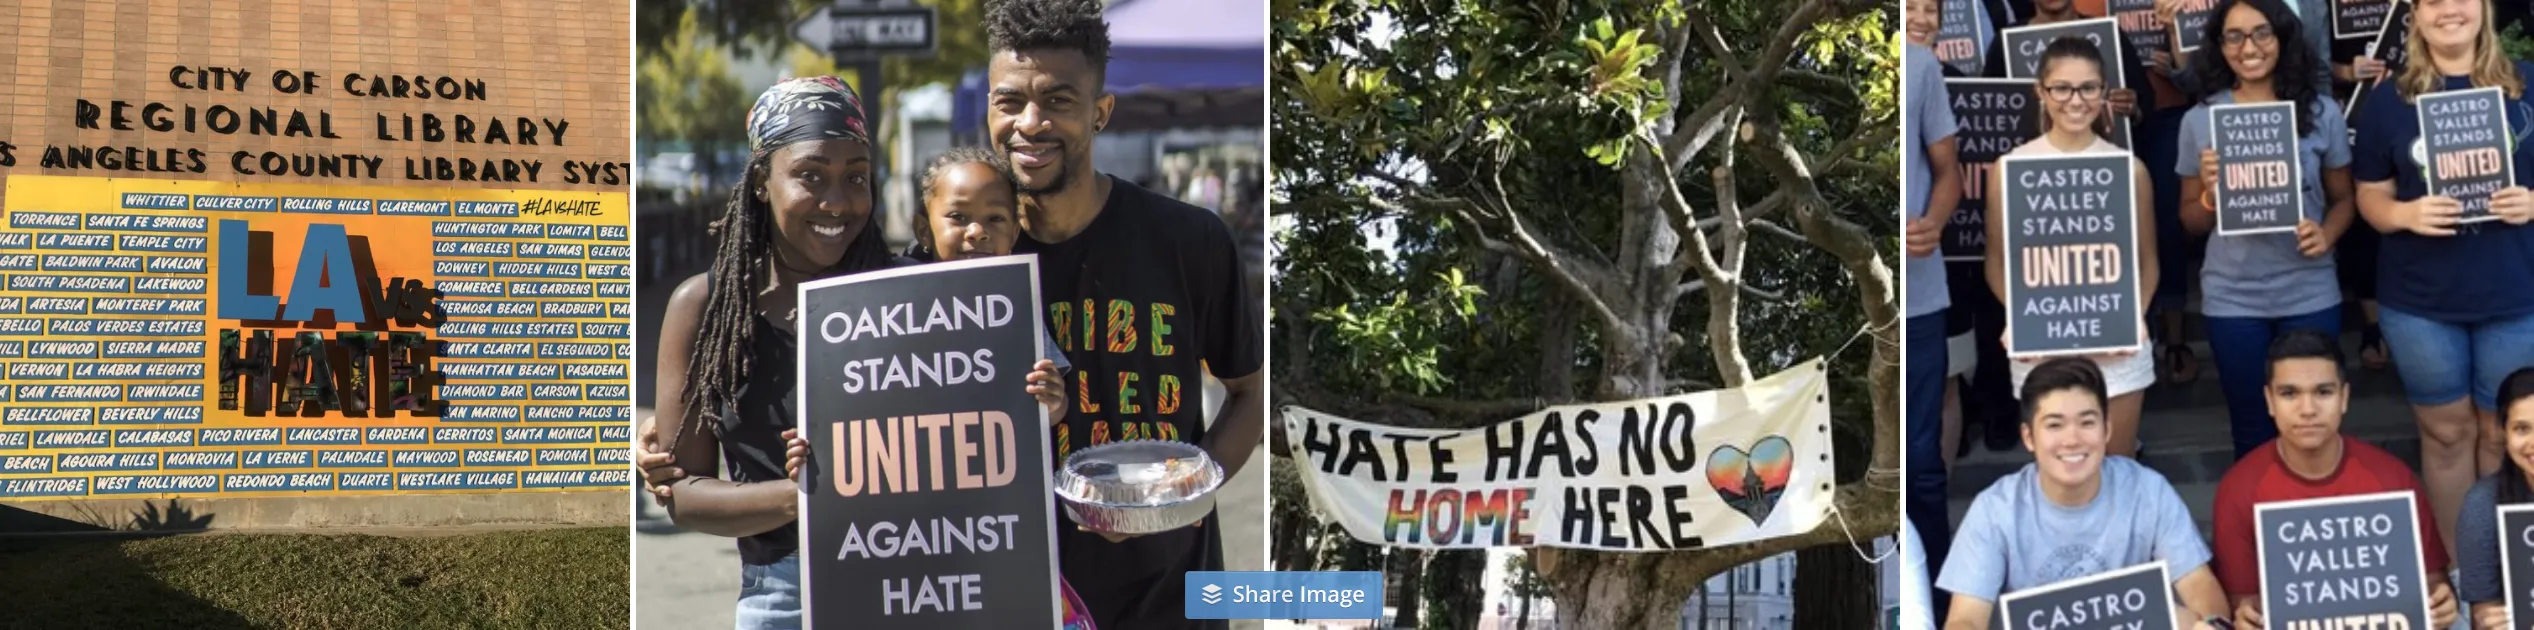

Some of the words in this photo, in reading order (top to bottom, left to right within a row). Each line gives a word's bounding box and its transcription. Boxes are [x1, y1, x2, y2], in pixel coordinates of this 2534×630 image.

[169, 65, 251, 92] CITY
[272, 69, 321, 94] OF
[343, 73, 486, 100] CARSON
[1953, 92, 2026, 109] ASTRO
[2429, 97, 2491, 116] CASTRO
[75, 99, 342, 139] REGIONAL
[377, 112, 569, 146] LIBRARY
[1958, 114, 2021, 132] ALLEY
[2221, 111, 2282, 127] CASTRO
[2434, 113, 2489, 130] VALLEY
[2226, 127, 2280, 141] VALLEY
[2434, 128, 2495, 147] STANDS
[2224, 141, 2285, 157] STANDS
[40, 144, 207, 173] ANGELES
[231, 150, 384, 179] COUNTY
[405, 156, 543, 182] LIBRARY
[2435, 146, 2501, 180] UNITED
[2019, 168, 2114, 188] CASTRO
[2224, 160, 2289, 190] UNITED
[2440, 180, 2503, 198] AGAINST
[125, 194, 186, 207] WHITTIER
[196, 196, 244, 209] CULVER
[244, 198, 274, 210] CITY
[283, 197, 333, 211] ROLLING
[337, 199, 371, 211] HILLS
[379, 201, 448, 213] CLAREMONT
[2025, 191, 2110, 212] VALLEY
[2228, 192, 2289, 208] AGAINST
[458, 202, 472, 214] EL
[473, 202, 516, 215] MONTE
[13, 212, 78, 226] TORRANCE
[88, 214, 131, 227] SANTA
[133, 216, 150, 228] FE
[151, 216, 205, 229] SPRINGS
[2242, 209, 2277, 223] HATE
[434, 222, 508, 235] HUNTINGTON
[511, 223, 542, 235] PARK
[550, 225, 591, 236] LOMITA
[599, 226, 625, 238] BELL
[2022, 214, 2116, 236] STANDS
[39, 234, 57, 246] LA
[60, 234, 110, 247] PUENTE
[121, 235, 171, 249] TEMPLE
[173, 237, 205, 249] CITY
[435, 241, 457, 253] LOS
[459, 242, 510, 254] ANGELES
[519, 243, 544, 255] SAN
[546, 244, 582, 256] DIMAS
[45, 255, 104, 268] BALDWIN
[104, 256, 140, 269] PARK
[150, 257, 204, 270] AVALON
[436, 261, 487, 274] DOWNEY
[2022, 242, 2121, 288] UNITED
[218, 219, 366, 323] LA
[498, 263, 544, 275] HIDDEN
[546, 264, 578, 276] HILLS
[11, 275, 56, 288] SOUTH
[58, 276, 126, 290] PASADENA
[137, 277, 205, 291] LAKEWOOD
[437, 281, 502, 294] COMMERCE
[511, 283, 538, 295] BELL
[540, 283, 591, 295] GARDENS
[29, 298, 86, 311] ARTESIA
[95, 299, 166, 311] MONTEREY
[168, 299, 204, 312] PARK
[440, 302, 493, 314] HERMOSA
[496, 302, 535, 315] BEACH
[543, 303, 603, 315] BRADBURY
[2023, 293, 2123, 316] AGAINST
[51, 319, 92, 333] PALOS
[96, 320, 145, 333] VERDES
[148, 320, 203, 333] ESTATES
[819, 293, 1014, 345] OAKLAND
[439, 322, 487, 335] ROLLING
[491, 323, 523, 335] HILLS
[526, 323, 575, 335] ESTATES
[1050, 298, 1176, 356] RIBE
[2047, 319, 2102, 339] HATE
[30, 342, 96, 355] LYNWOOD
[106, 341, 154, 355] SIERRA
[156, 341, 203, 354] MADRE
[482, 343, 531, 355] CLARITA
[540, 343, 554, 355] EL
[555, 344, 609, 356] SEGUNDO
[11, 363, 66, 377] VERNON
[75, 363, 94, 376] LA
[97, 363, 143, 377] HABRA
[145, 363, 202, 376] HEIGHTS
[218, 328, 428, 412] HATE
[441, 363, 515, 376] MANHATTAN
[518, 364, 557, 376] BEACH
[566, 364, 625, 376] PASADENA
[842, 348, 996, 395] STANDS
[18, 385, 48, 399] SAN
[50, 385, 121, 399] FERNANDO
[129, 385, 201, 398] IRWINDALE
[441, 385, 497, 397] DIAMOND
[500, 385, 524, 397] BAR
[534, 385, 580, 397] CARSON
[589, 385, 627, 397] AZUSA
[6, 408, 92, 422] BELLFLOWER
[101, 407, 161, 421] BEVERLY
[163, 407, 201, 420] HILLS
[36, 431, 108, 445] LAWNDALE
[117, 430, 192, 444] CALABASAS
[201, 429, 232, 442] PICO
[232, 428, 279, 442] RIVERA
[288, 428, 359, 441] LANCASTER
[368, 427, 426, 441] GARDENA
[435, 428, 494, 441] CERRITOS
[504, 427, 544, 441] SANTA
[547, 427, 593, 440] MONICA
[1303, 416, 1463, 484] HATE
[1484, 409, 1600, 482] HAS
[1618, 401, 1698, 476] NO
[60, 454, 116, 468] AGOURA
[119, 453, 157, 467] HILLS
[166, 452, 235, 466] MONROVIA
[245, 451, 263, 465] LA
[267, 451, 308, 465] VERNE
[321, 451, 385, 464] PALMDALE
[395, 451, 457, 464] MAYWOOD
[466, 450, 530, 463] ROSEMEAD
[539, 449, 588, 462] POMONA
[831, 410, 1018, 498] UNITED
[3, 456, 51, 470] BEACH
[5, 478, 86, 493] FLINTRIDGE
[96, 476, 134, 490] WEST
[137, 475, 216, 489] HOLLYWOOD
[226, 474, 286, 488] REDONDO
[289, 473, 332, 487] BEACH
[341, 473, 390, 487] DUARTE
[400, 473, 462, 487] WESTLAKE
[466, 472, 515, 486] VILLAGE
[1383, 486, 1537, 546] HOME
[1560, 485, 1705, 548] HERE
[2277, 513, 2393, 544] CASTRO
[837, 514, 1019, 561] AGAINST
[2286, 544, 2390, 575] VALLEY
[881, 573, 983, 616] HATE
[2285, 575, 2400, 606] STANDS
[2027, 588, 2146, 630] CASTRO
